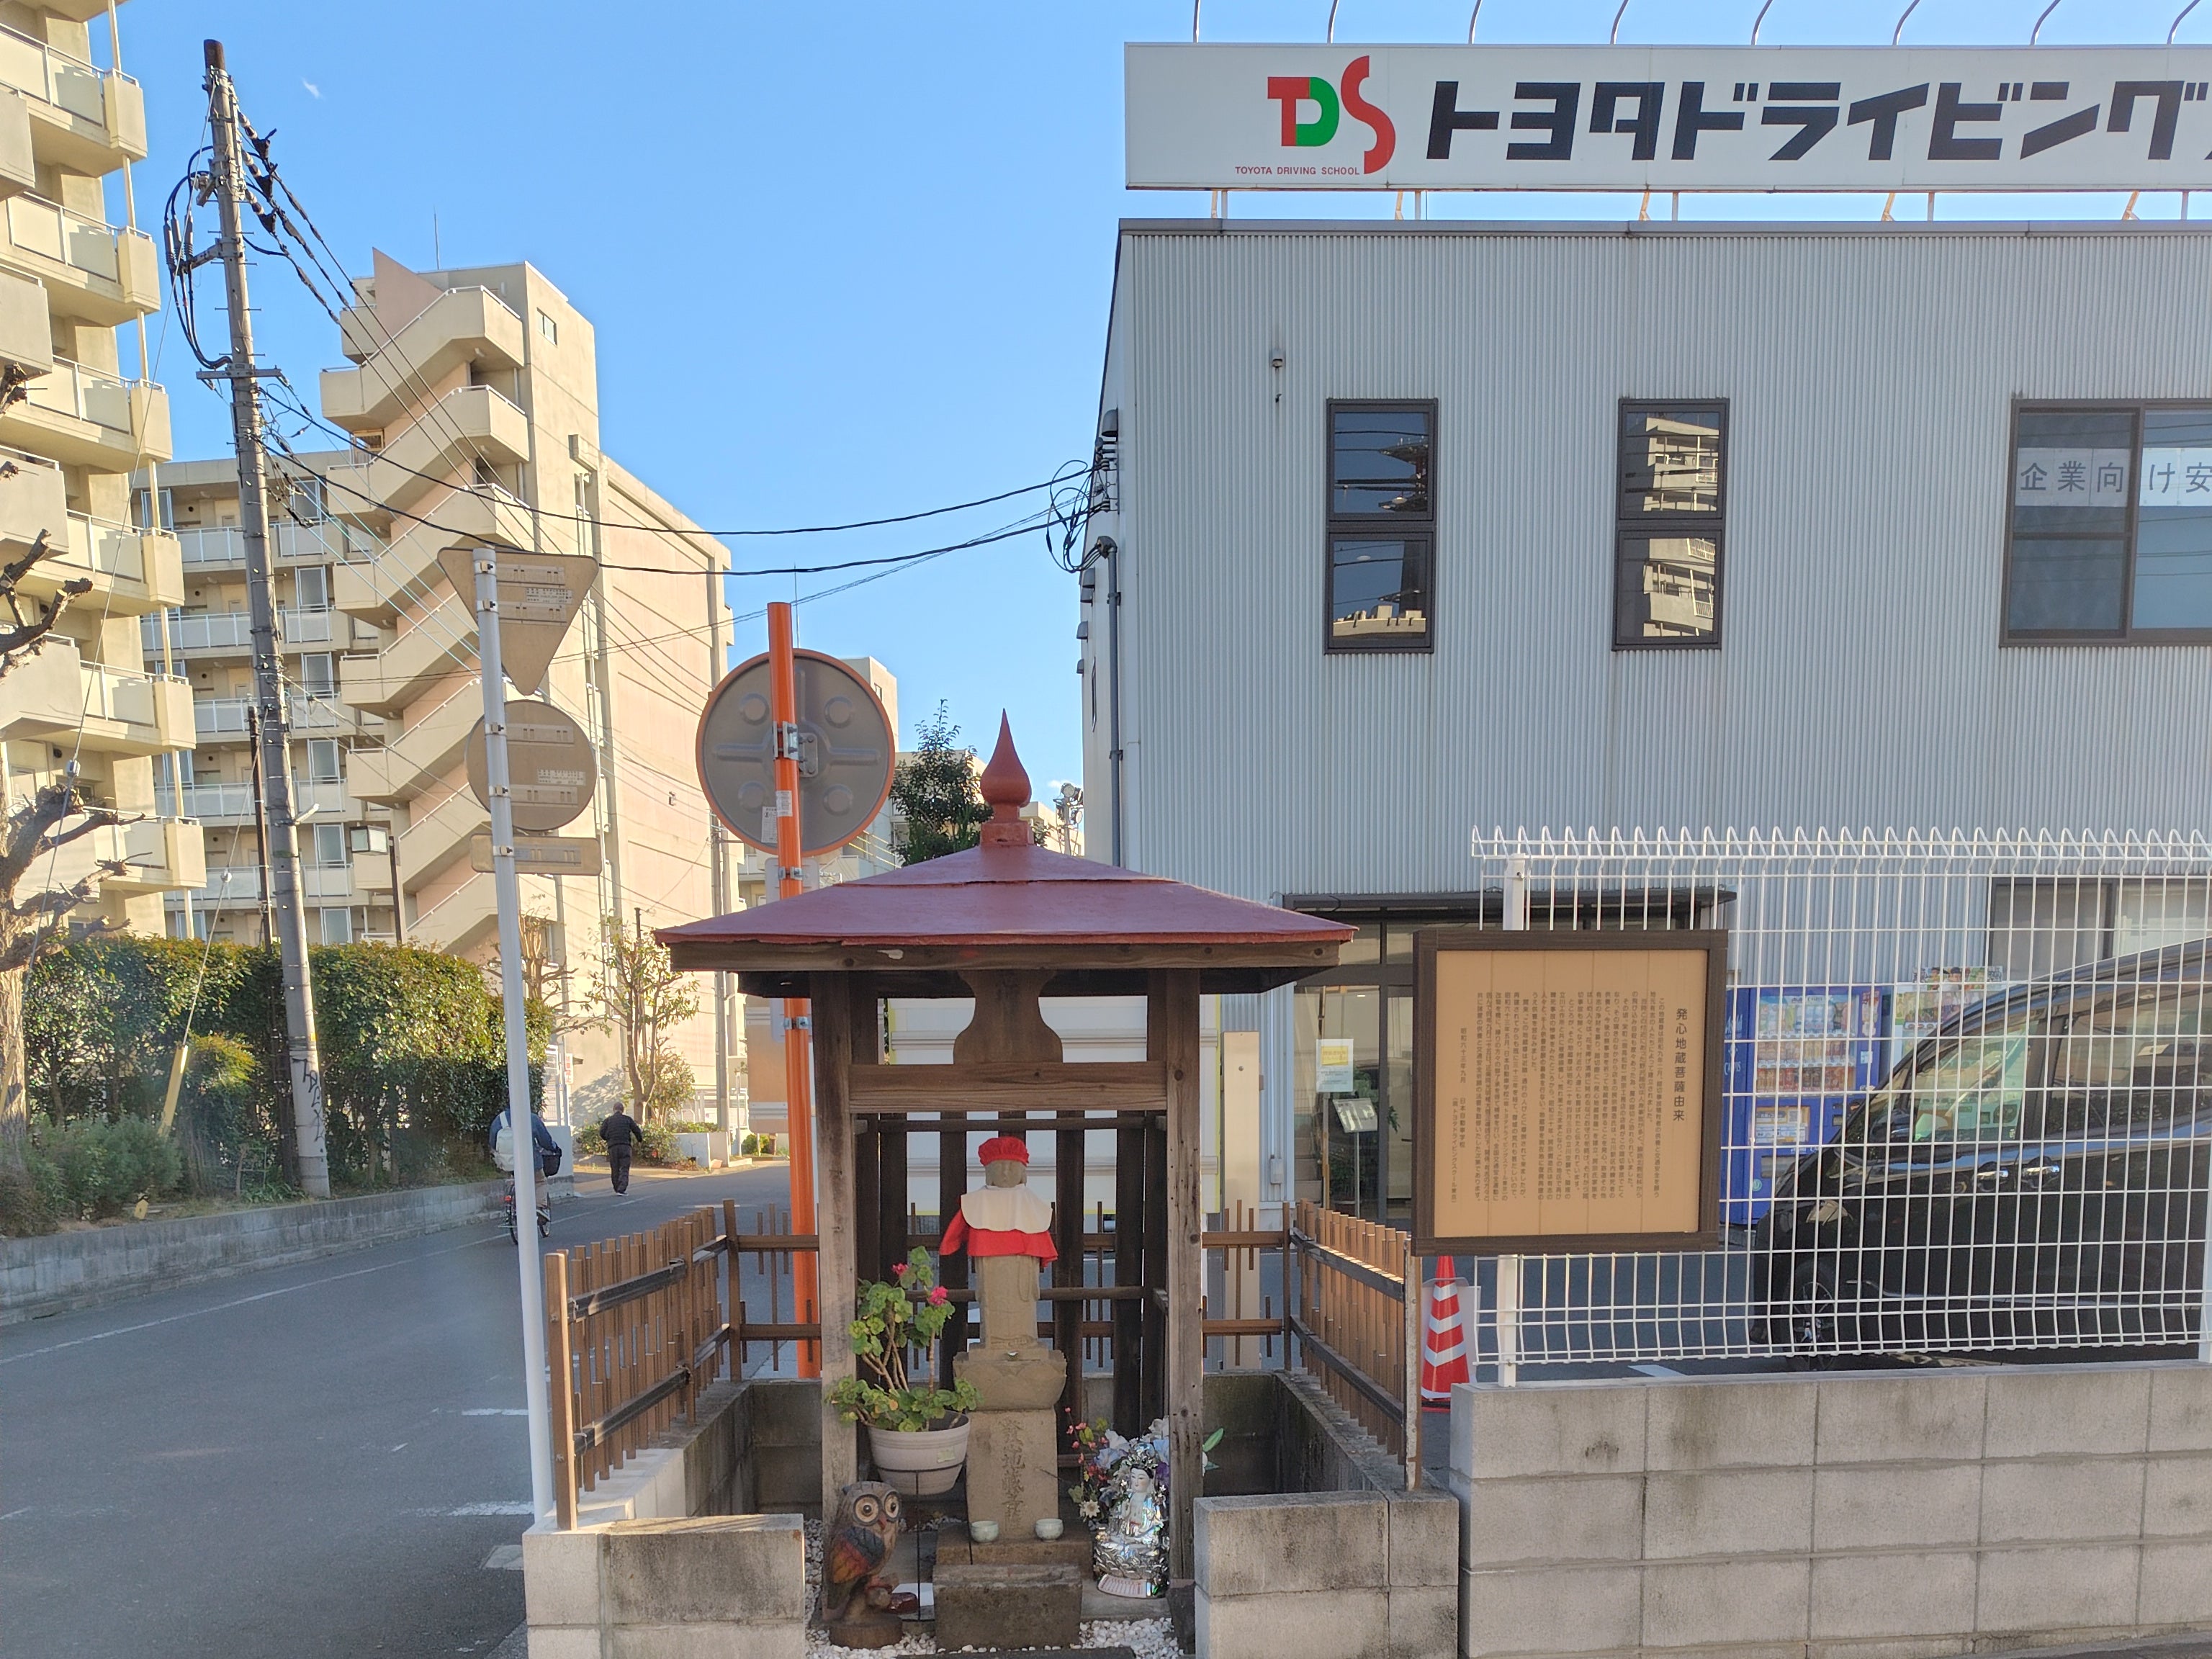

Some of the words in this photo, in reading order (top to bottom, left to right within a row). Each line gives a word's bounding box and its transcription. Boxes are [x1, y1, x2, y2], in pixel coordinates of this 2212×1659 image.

[1267, 55, 1396, 174] TDS
[1426, 80, 2212, 161] トヨタドライビング
[1277, 166, 1316, 175] DRIVING
[1321, 166, 1359, 175] SCHOOL
[1673, 1008, 1688, 1121] 発心地蔵菩薩由来
